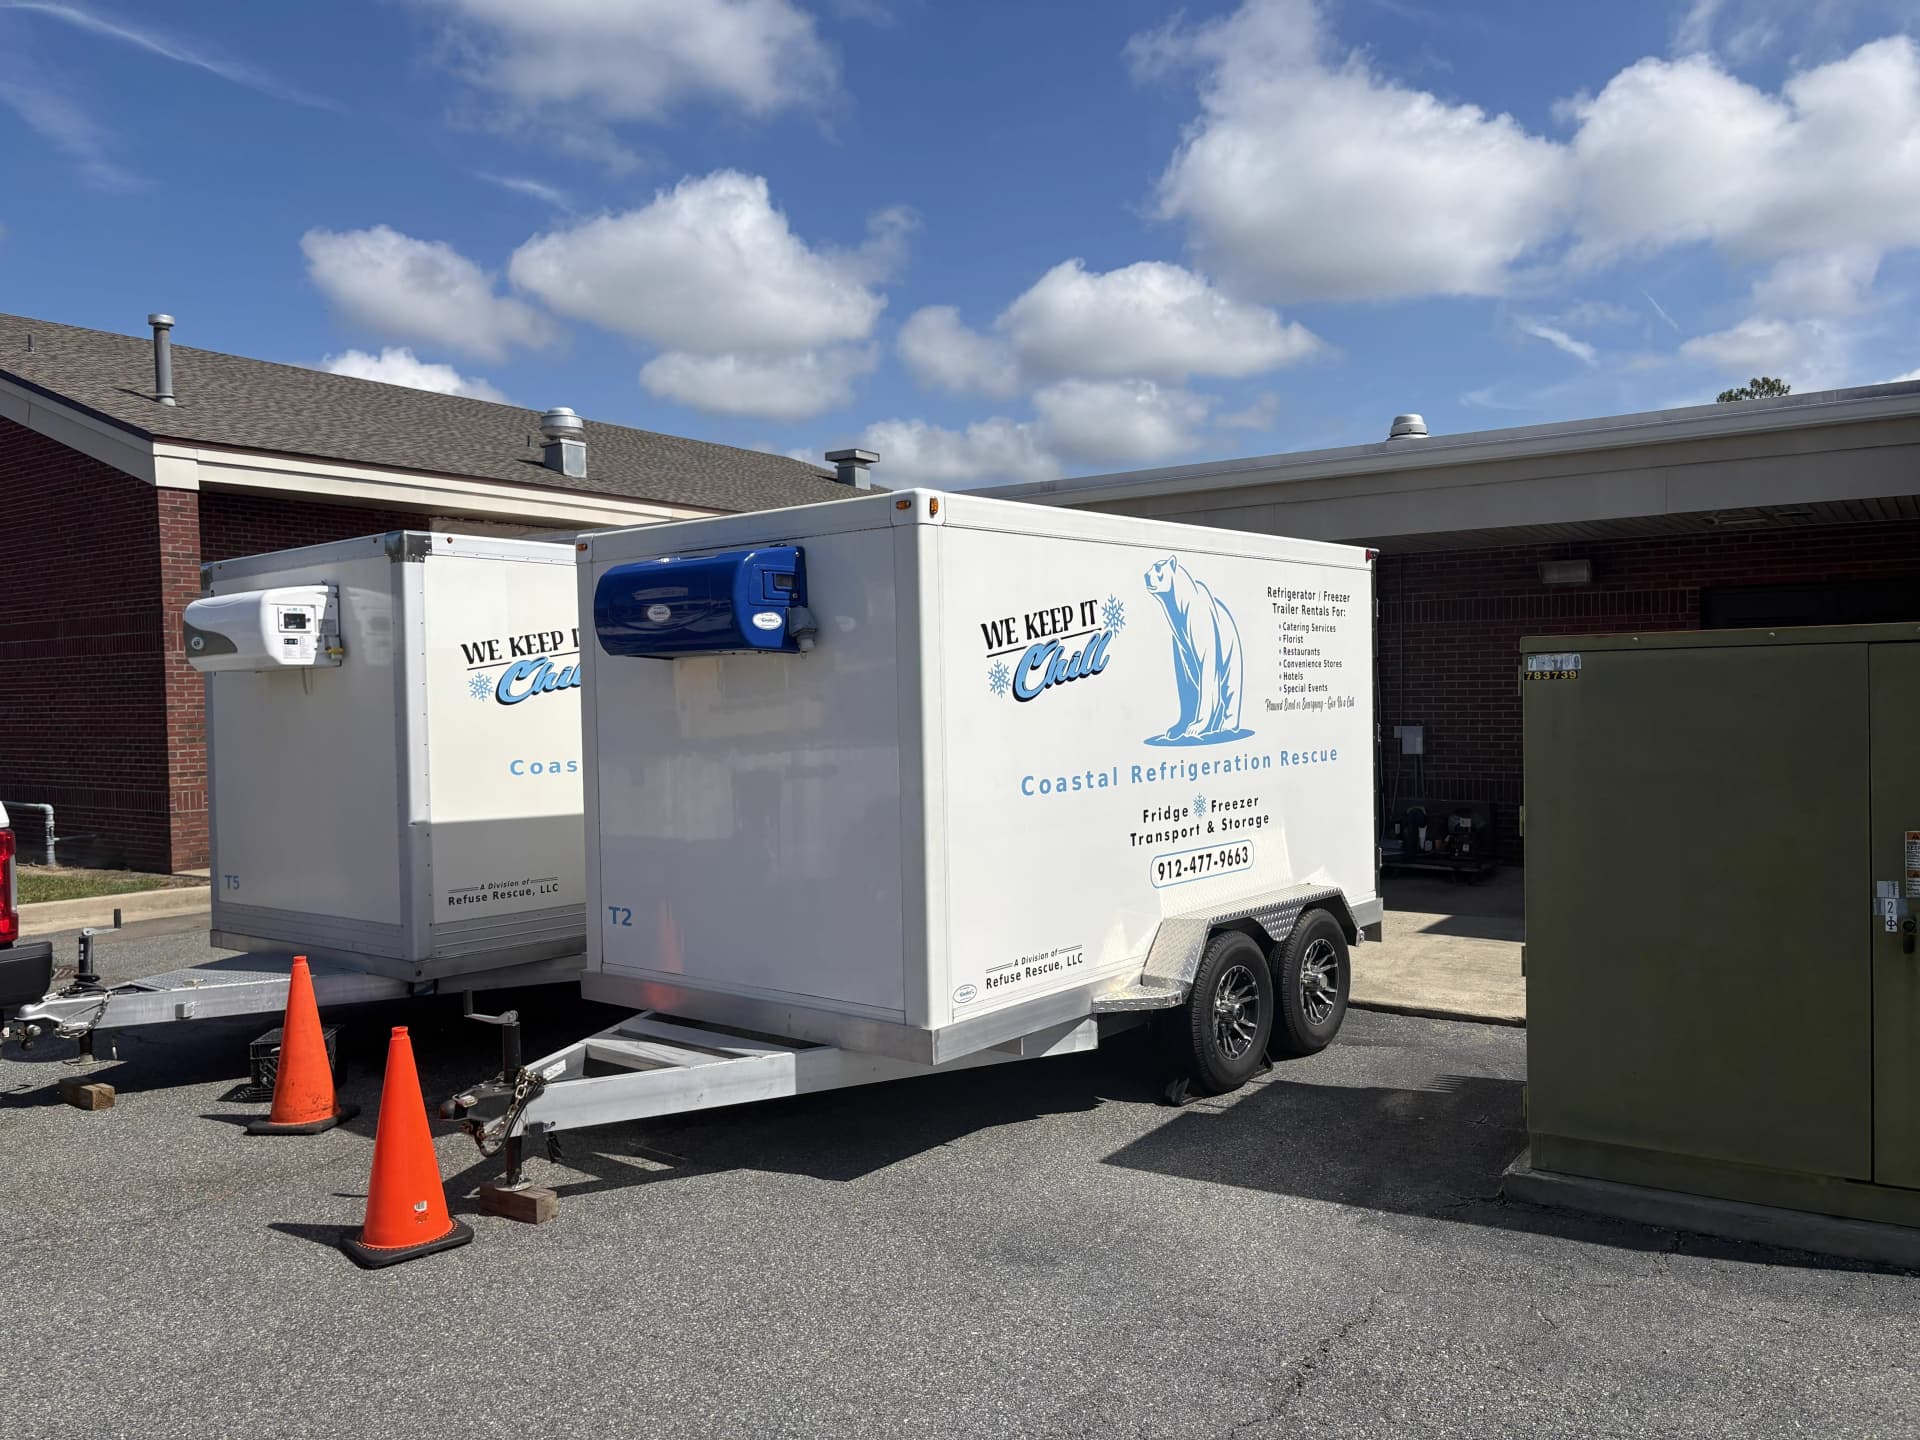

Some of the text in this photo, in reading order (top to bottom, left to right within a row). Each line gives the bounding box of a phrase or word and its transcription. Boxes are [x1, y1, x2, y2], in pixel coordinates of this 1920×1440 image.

[1267, 586, 1316, 601] Refrigerator
[1323, 590, 1350, 603] Freezer
[1272, 602, 1346, 617] Trailer Rentals For:
[980, 599, 1098, 650] WE KEEP IT
[1282, 621, 1337, 634] Catering Services
[460, 628, 579, 665] WE KEEP I
[1282, 634, 1304, 644] Florist
[1282, 646, 1321, 656] Restaurants
[1012, 630, 1113, 702] Chill
[1282, 659, 1343, 669] Convenience Stores
[495, 656, 582, 705] Chi
[1283, 671, 1304, 681] Hotels
[1525, 670, 1577, 680] 783739
[1283, 683, 1328, 695] Special Events
[1021, 748, 1338, 796] Coastal Refrigeration Rescue
[1143, 797, 1259, 823] Fridge Freezer
[1130, 814, 1270, 847] Transport & Storage
[1157, 846, 1249, 881] 912-477-9663
[224, 874, 241, 890] T5
[488, 880, 519, 890] Division
[522, 877, 530, 885] of
[448, 883, 559, 906] Refuse Rescue, LLC
[608, 906, 633, 927] T2
[1021, 951, 1049, 966] Division
[1050, 948, 1059, 958] of
[985, 952, 1083, 990] Refuse Rescue, LLC
